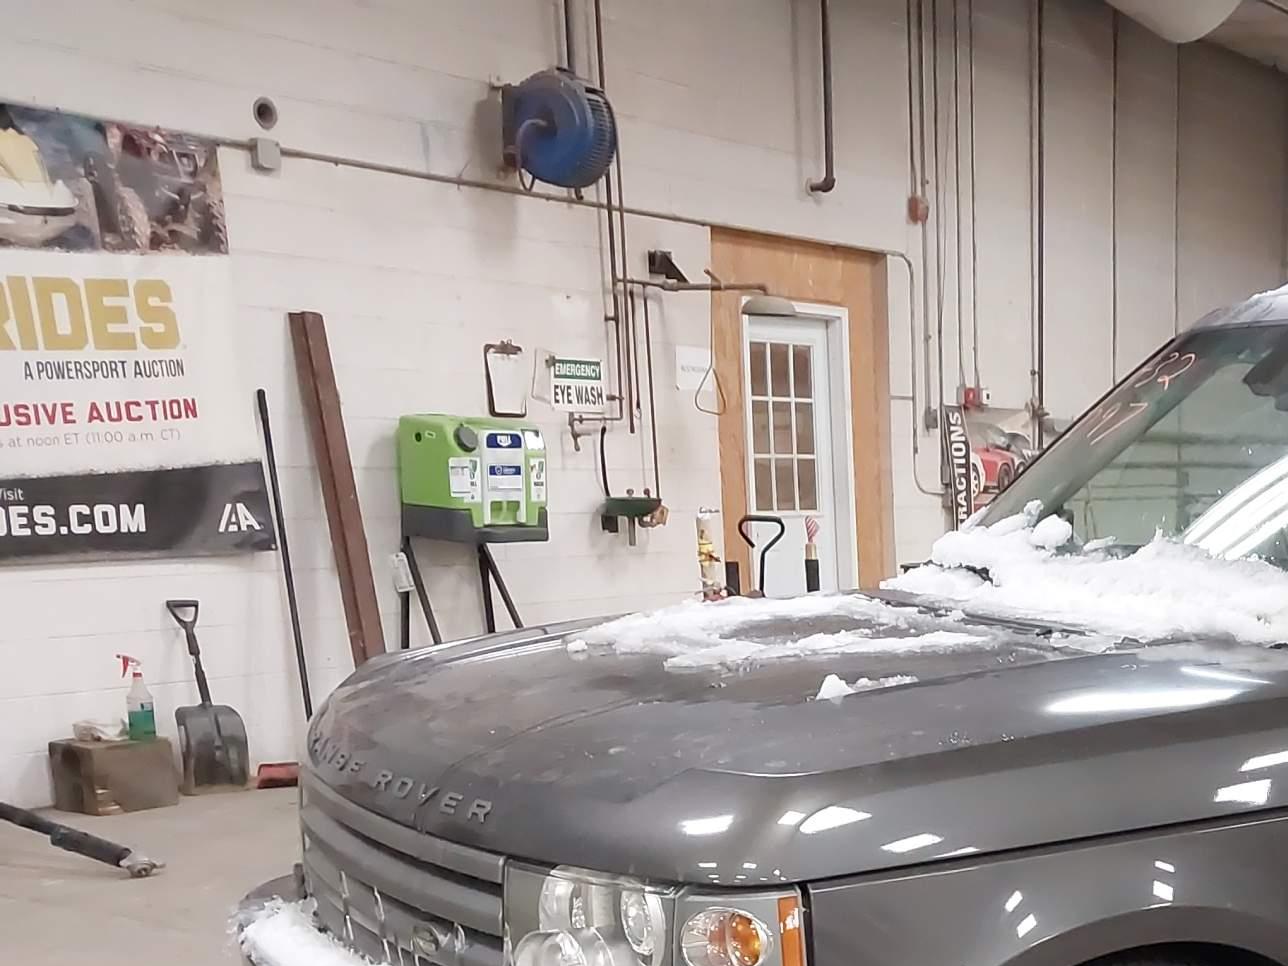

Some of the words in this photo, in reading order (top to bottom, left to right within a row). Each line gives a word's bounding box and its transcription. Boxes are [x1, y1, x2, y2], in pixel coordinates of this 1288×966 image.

[24, 361, 34, 381] A
[38, 360, 128, 381] POWERSPORT
[133, 358, 186, 379] AUCTION
[555, 362, 600, 379] EMERGENCY
[553, 384, 573, 404] EYE
[575, 384, 604, 406] WASH
[87, 398, 199, 424] AUCTION
[8, 436, 22, 448] at
[27, 435, 60, 447] noon
[64, 432, 80, 446] ET
[160, 428, 182, 442] CT)
[372, 769, 493, 824] ROVER
